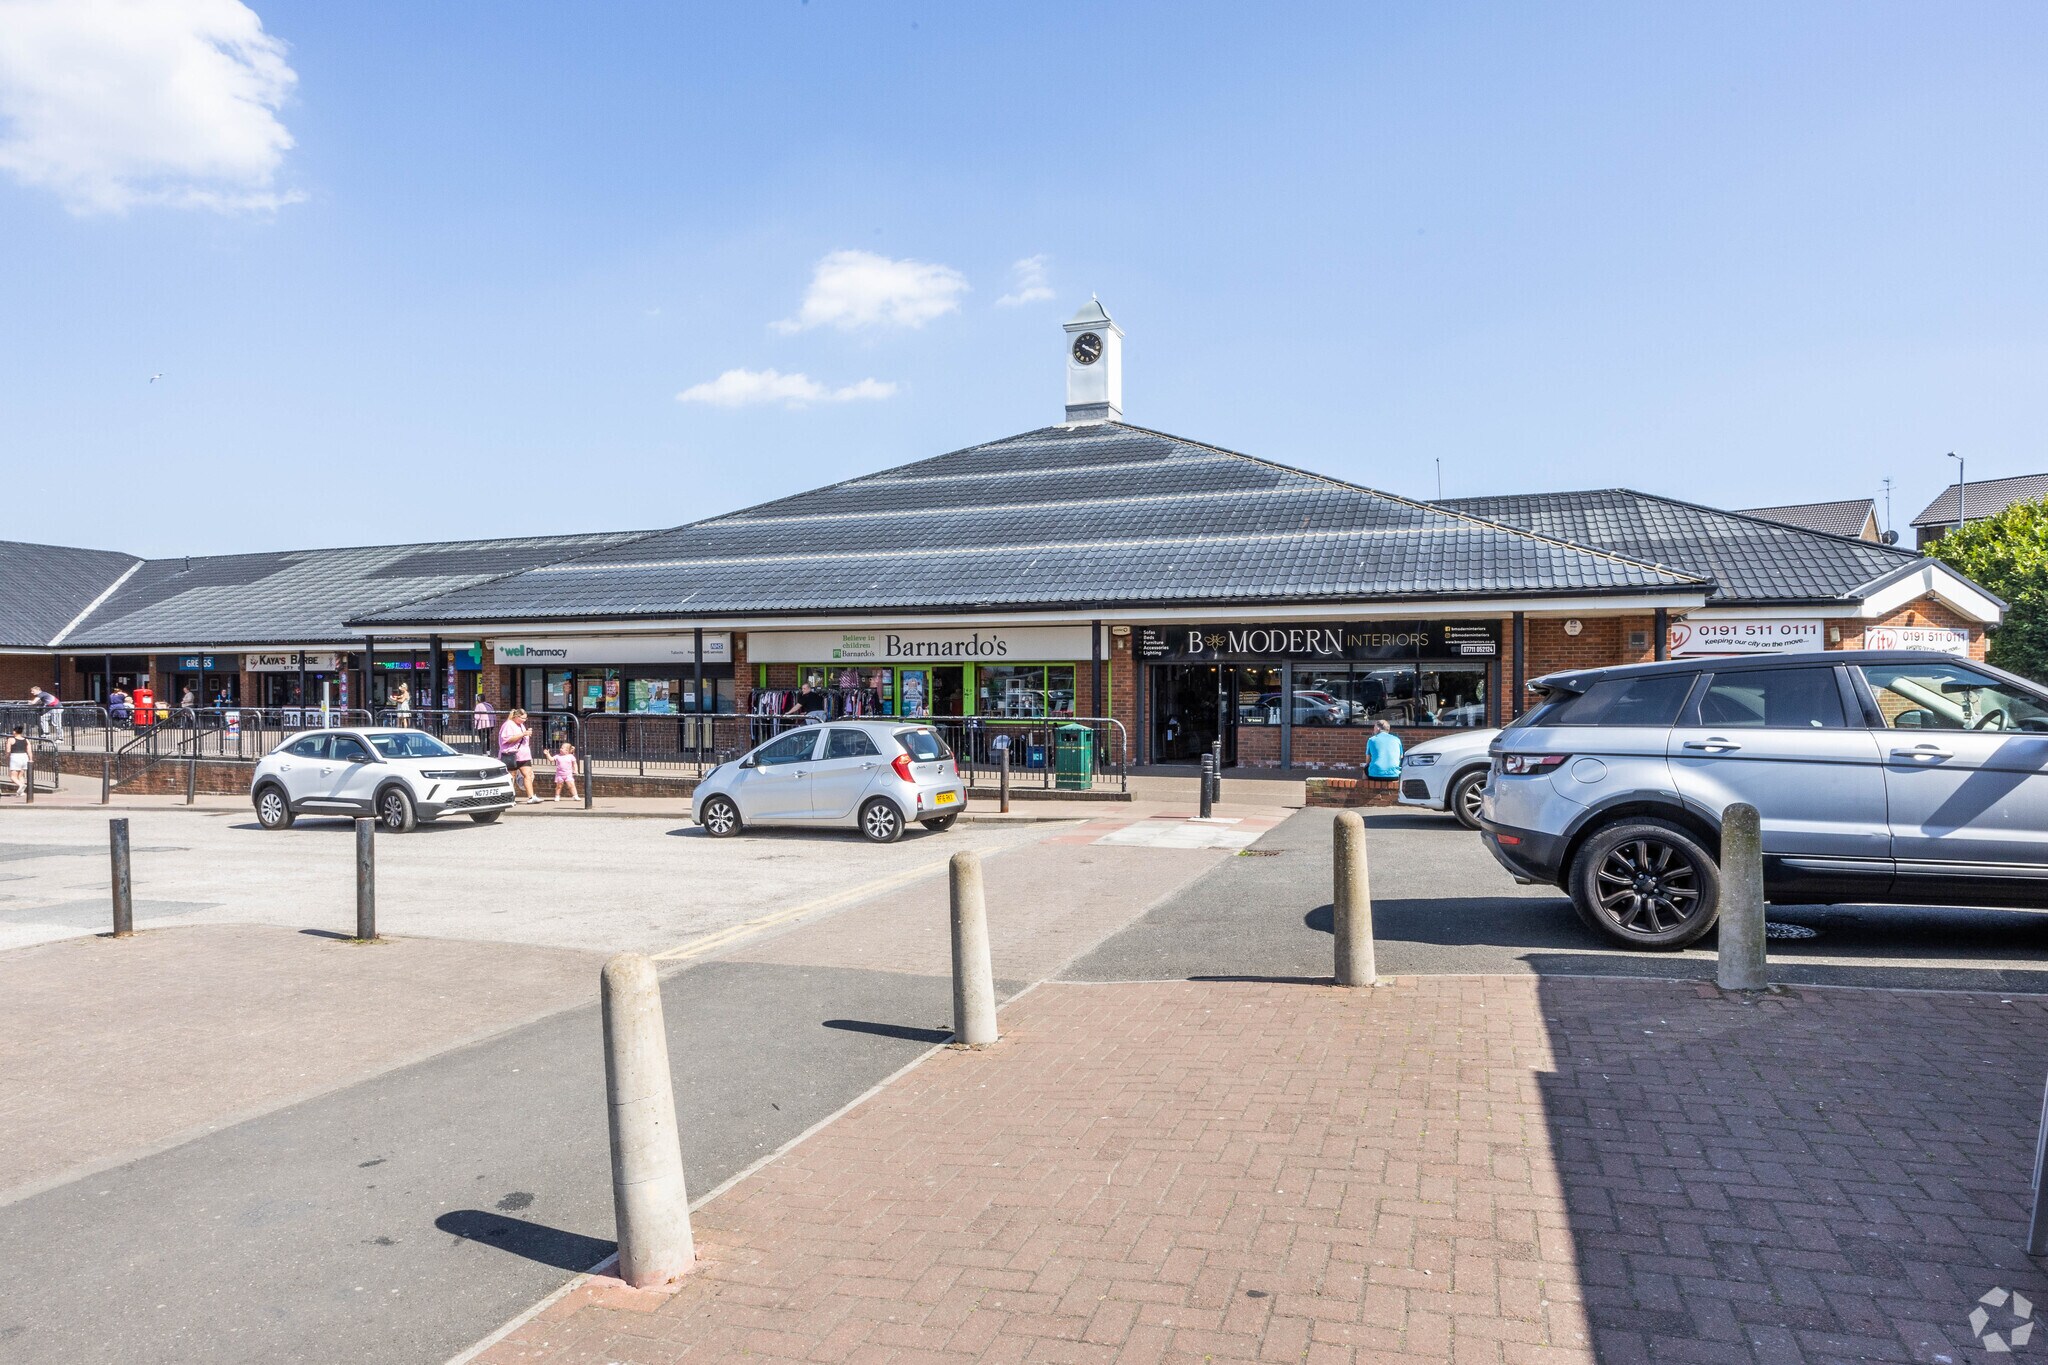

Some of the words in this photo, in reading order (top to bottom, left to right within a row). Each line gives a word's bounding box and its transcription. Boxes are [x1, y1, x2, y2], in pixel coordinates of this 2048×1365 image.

[1699, 625, 1737, 636] 0191
[1745, 625, 1772, 636] 511
[1780, 624, 1817, 635] 0111
[1188, 631, 1204, 653] B
[1228, 629, 1343, 655] MODERN
[1347, 633, 1429, 646] INTERIORS
[1902, 631, 1924, 641] 0191
[1928, 632, 1943, 641] 511
[1946, 632, 1965, 642] 0111
[885, 633, 1007, 657] Barnardo's
[1704, 638, 1733, 646] Keeping
[1748, 640, 1760, 648] city
[505, 645, 525, 656] well
[526, 647, 567, 658] Pharmacy
[186, 658, 212, 668] GREGS
